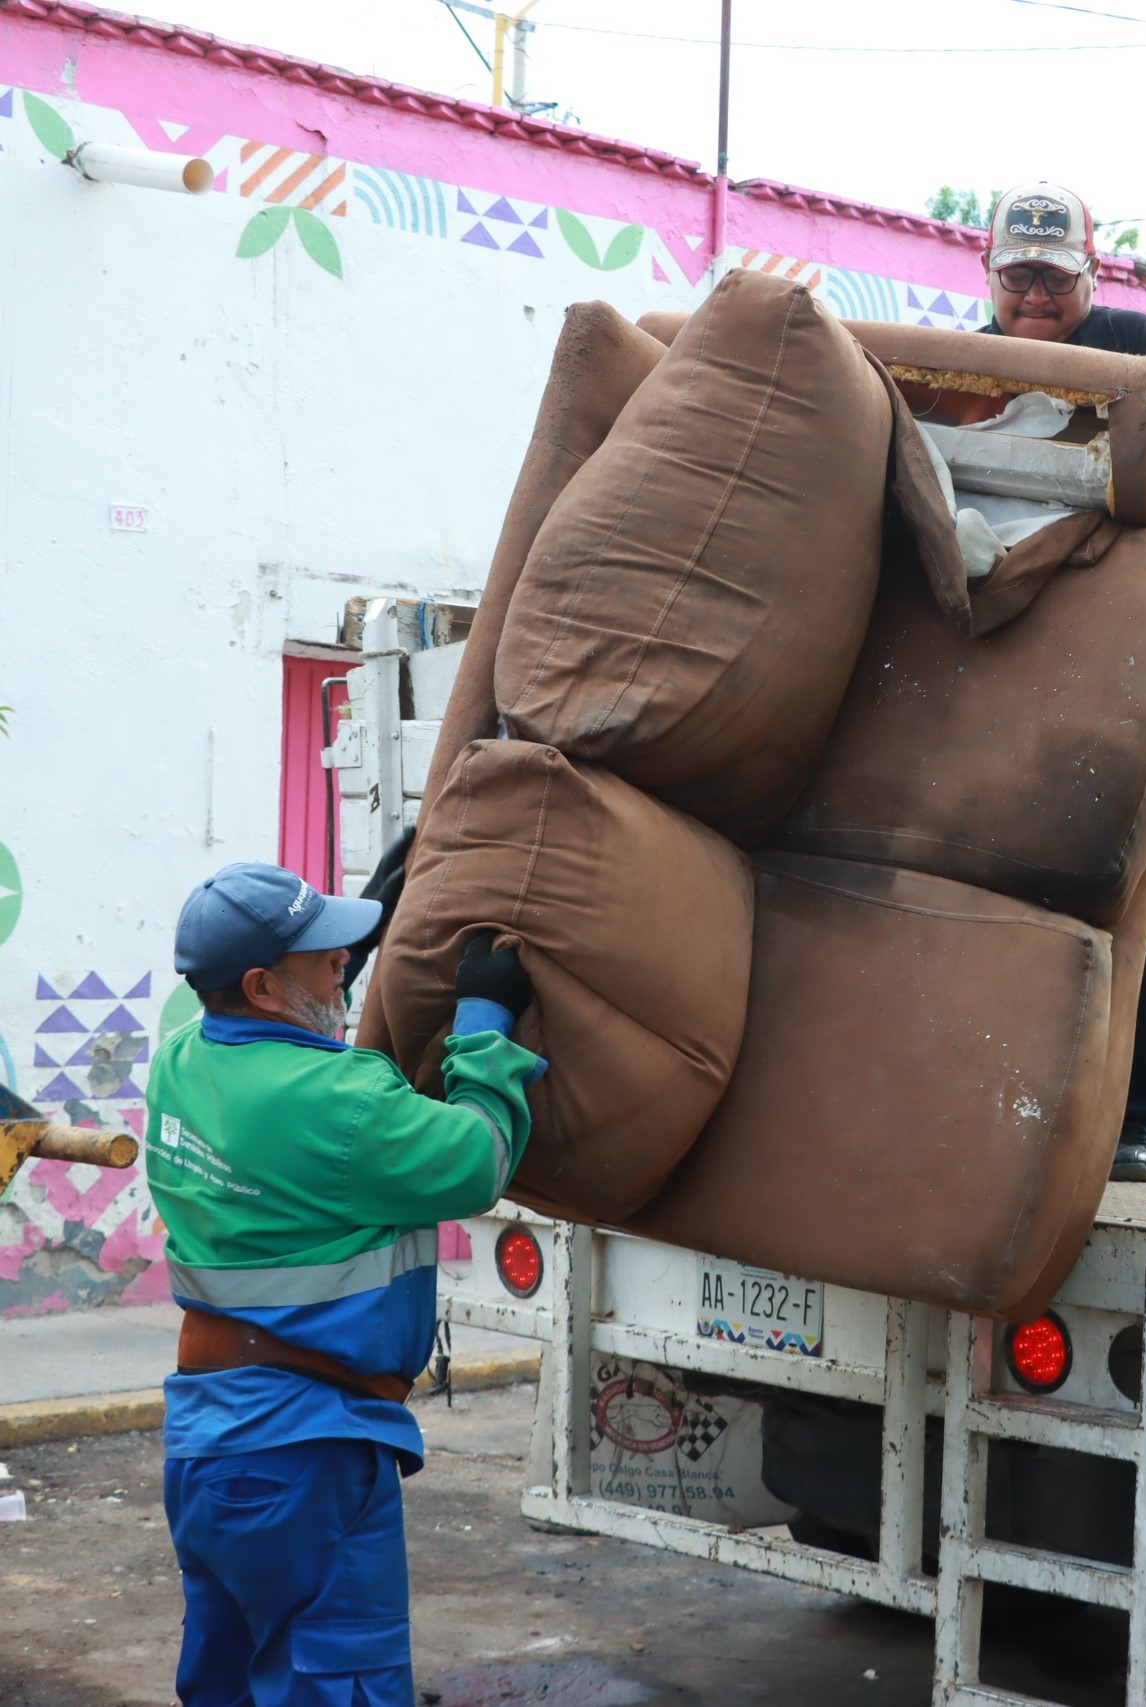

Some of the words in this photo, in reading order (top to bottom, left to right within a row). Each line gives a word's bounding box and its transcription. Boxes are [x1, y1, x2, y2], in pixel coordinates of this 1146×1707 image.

[702, 1271, 816, 1326] AA-1232-F
[645, 1466, 674, 1480] Casa
[599, 1480, 641, 1501] (449)
